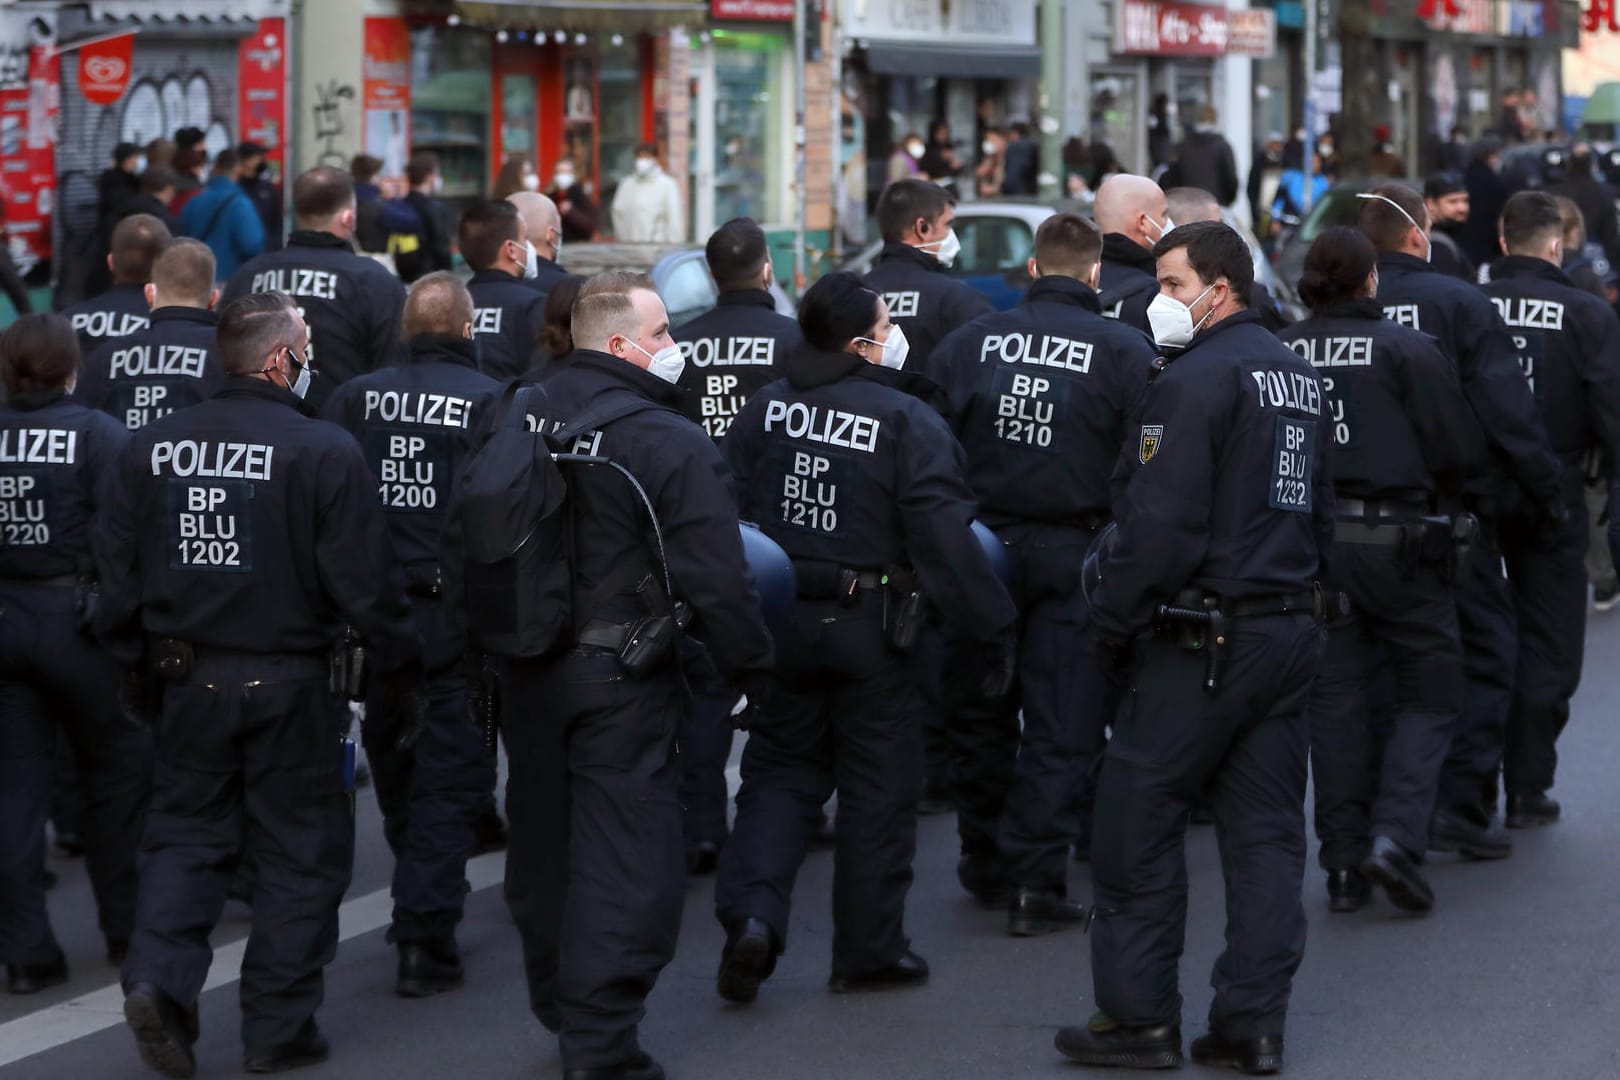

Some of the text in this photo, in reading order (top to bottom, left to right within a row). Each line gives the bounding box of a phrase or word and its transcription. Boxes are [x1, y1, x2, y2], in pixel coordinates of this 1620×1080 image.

[110, 345, 207, 379] POLIZEI
[980, 332, 1094, 373] POLIZEI
[134, 386, 167, 407] BP
[706, 375, 738, 396] BP
[1011, 374, 1050, 399] BP
[1251, 371, 1321, 416] POLIZEI
[364, 390, 473, 429] POLIZEI
[998, 394, 1054, 424] BLU
[764, 400, 880, 453] POLIZEI
[994, 419, 1052, 448] 1210
[1143, 428, 1161, 436] POLIZEI
[1285, 424, 1305, 450] BP
[152, 440, 274, 480] POLIZEI
[389, 436, 425, 459] BP
[381, 459, 434, 485] BLU
[794, 452, 830, 479] BP
[1278, 450, 1306, 478] BLU
[188, 487, 227, 512] BP
[378, 483, 437, 509] 1200
[783, 474, 836, 507] BLU
[179, 513, 236, 539] BLU
[780, 499, 837, 532] 1210
[178, 540, 241, 566] 1202
